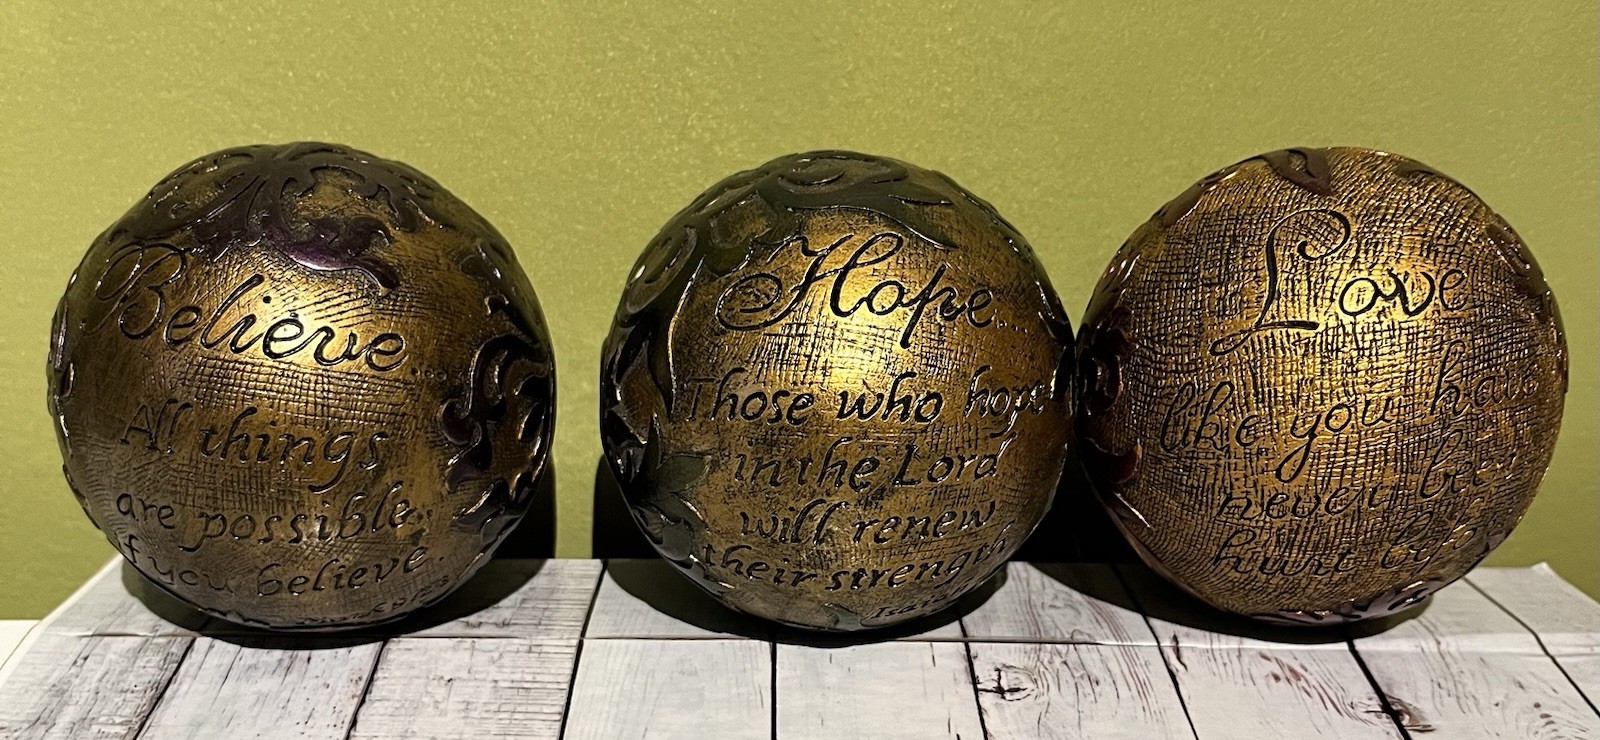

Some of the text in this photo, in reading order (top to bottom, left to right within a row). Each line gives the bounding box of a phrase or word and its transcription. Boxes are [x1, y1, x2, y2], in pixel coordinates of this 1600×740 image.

[1210, 208, 1468, 356] Love
[686, 364, 1044, 438] Those who hope
[1160, 380, 1259, 453] like
[1274, 398, 1394, 484] you
[118, 398, 388, 493] All things
[734, 432, 1018, 493] in the Lord
[116, 491, 176, 530] are
[738, 498, 997, 547] will renew
[1218, 478, 1396, 522] never
[147, 554, 235, 597] you
[256, 545, 445, 597] believe.
[702, 519, 1017, 592] their strength
[1213, 498, 1478, 578] hurt befo
